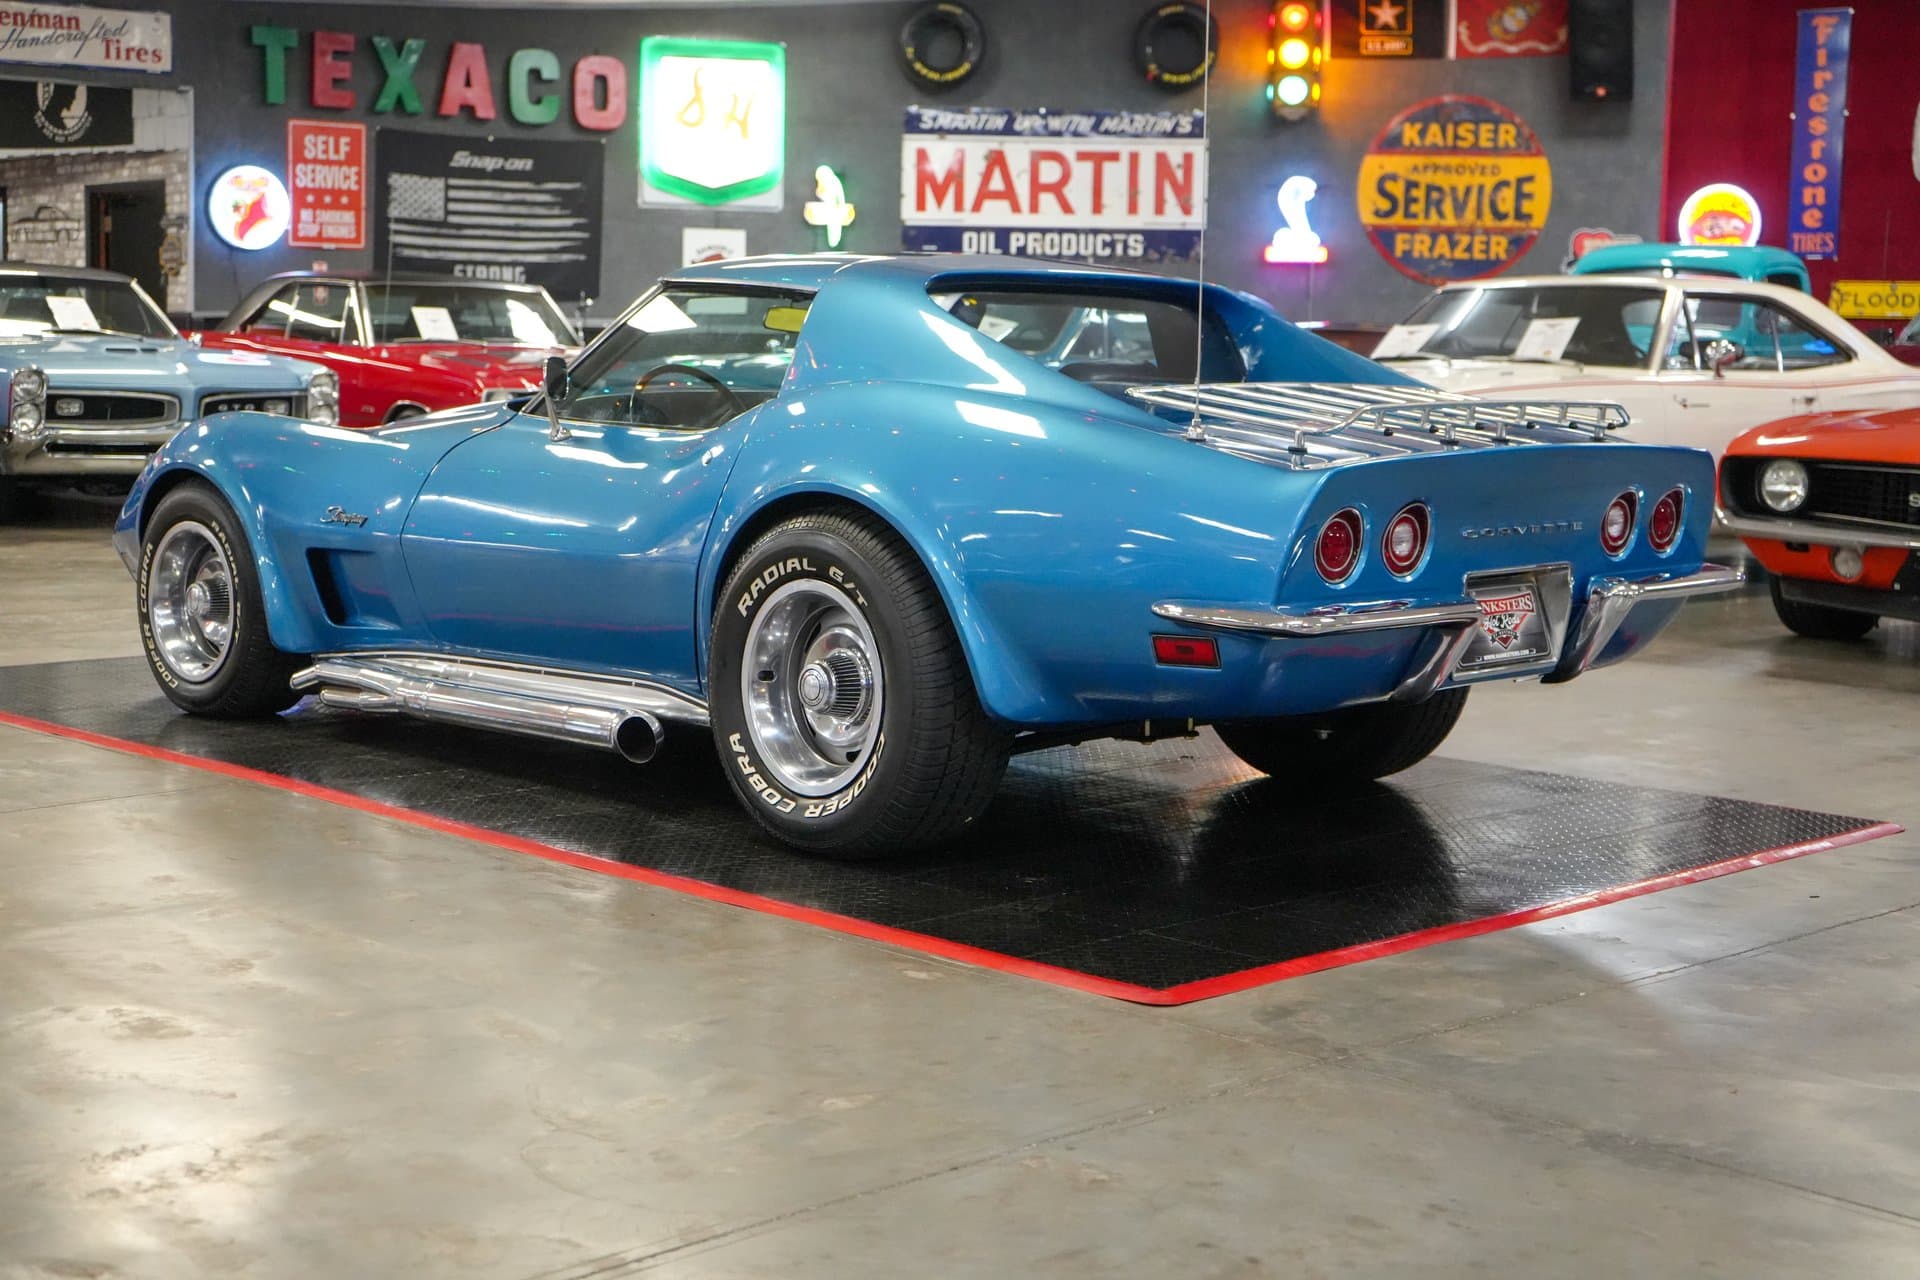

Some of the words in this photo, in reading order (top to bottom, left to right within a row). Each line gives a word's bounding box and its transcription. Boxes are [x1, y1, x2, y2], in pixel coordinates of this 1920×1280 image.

[0, 15, 129, 58] Handcrafted
[102, 37, 163, 63] Tires
[251, 25, 627, 131] TEXACO
[1401, 121, 1518, 149] KAISER
[1802, 15, 1840, 229] Firestone
[303, 133, 351, 161] SELF
[295, 163, 360, 191] SERVICE
[915, 147, 1194, 217] MARTIN
[1411, 163, 1501, 177] APPROVED
[1373, 173, 1536, 222] SERVICE
[961, 231, 1002, 255] OIL
[1008, 233, 1145, 258] PRODUCTS
[1393, 232, 1510, 261] FRAZER
[1792, 232, 1834, 253] TIRES
[1839, 291, 1920, 309] FLOOD
[1462, 521, 1583, 539] CORVETTE
[140, 542, 154, 614] COBRA
[737, 556, 818, 618] RADIAL
[827, 565, 869, 608] G/T
[1480, 594, 1534, 614] NKSTERS
[142, 623, 180, 690] COOPER
[728, 732, 797, 814] COBRA
[803, 731, 886, 819] COOPER
